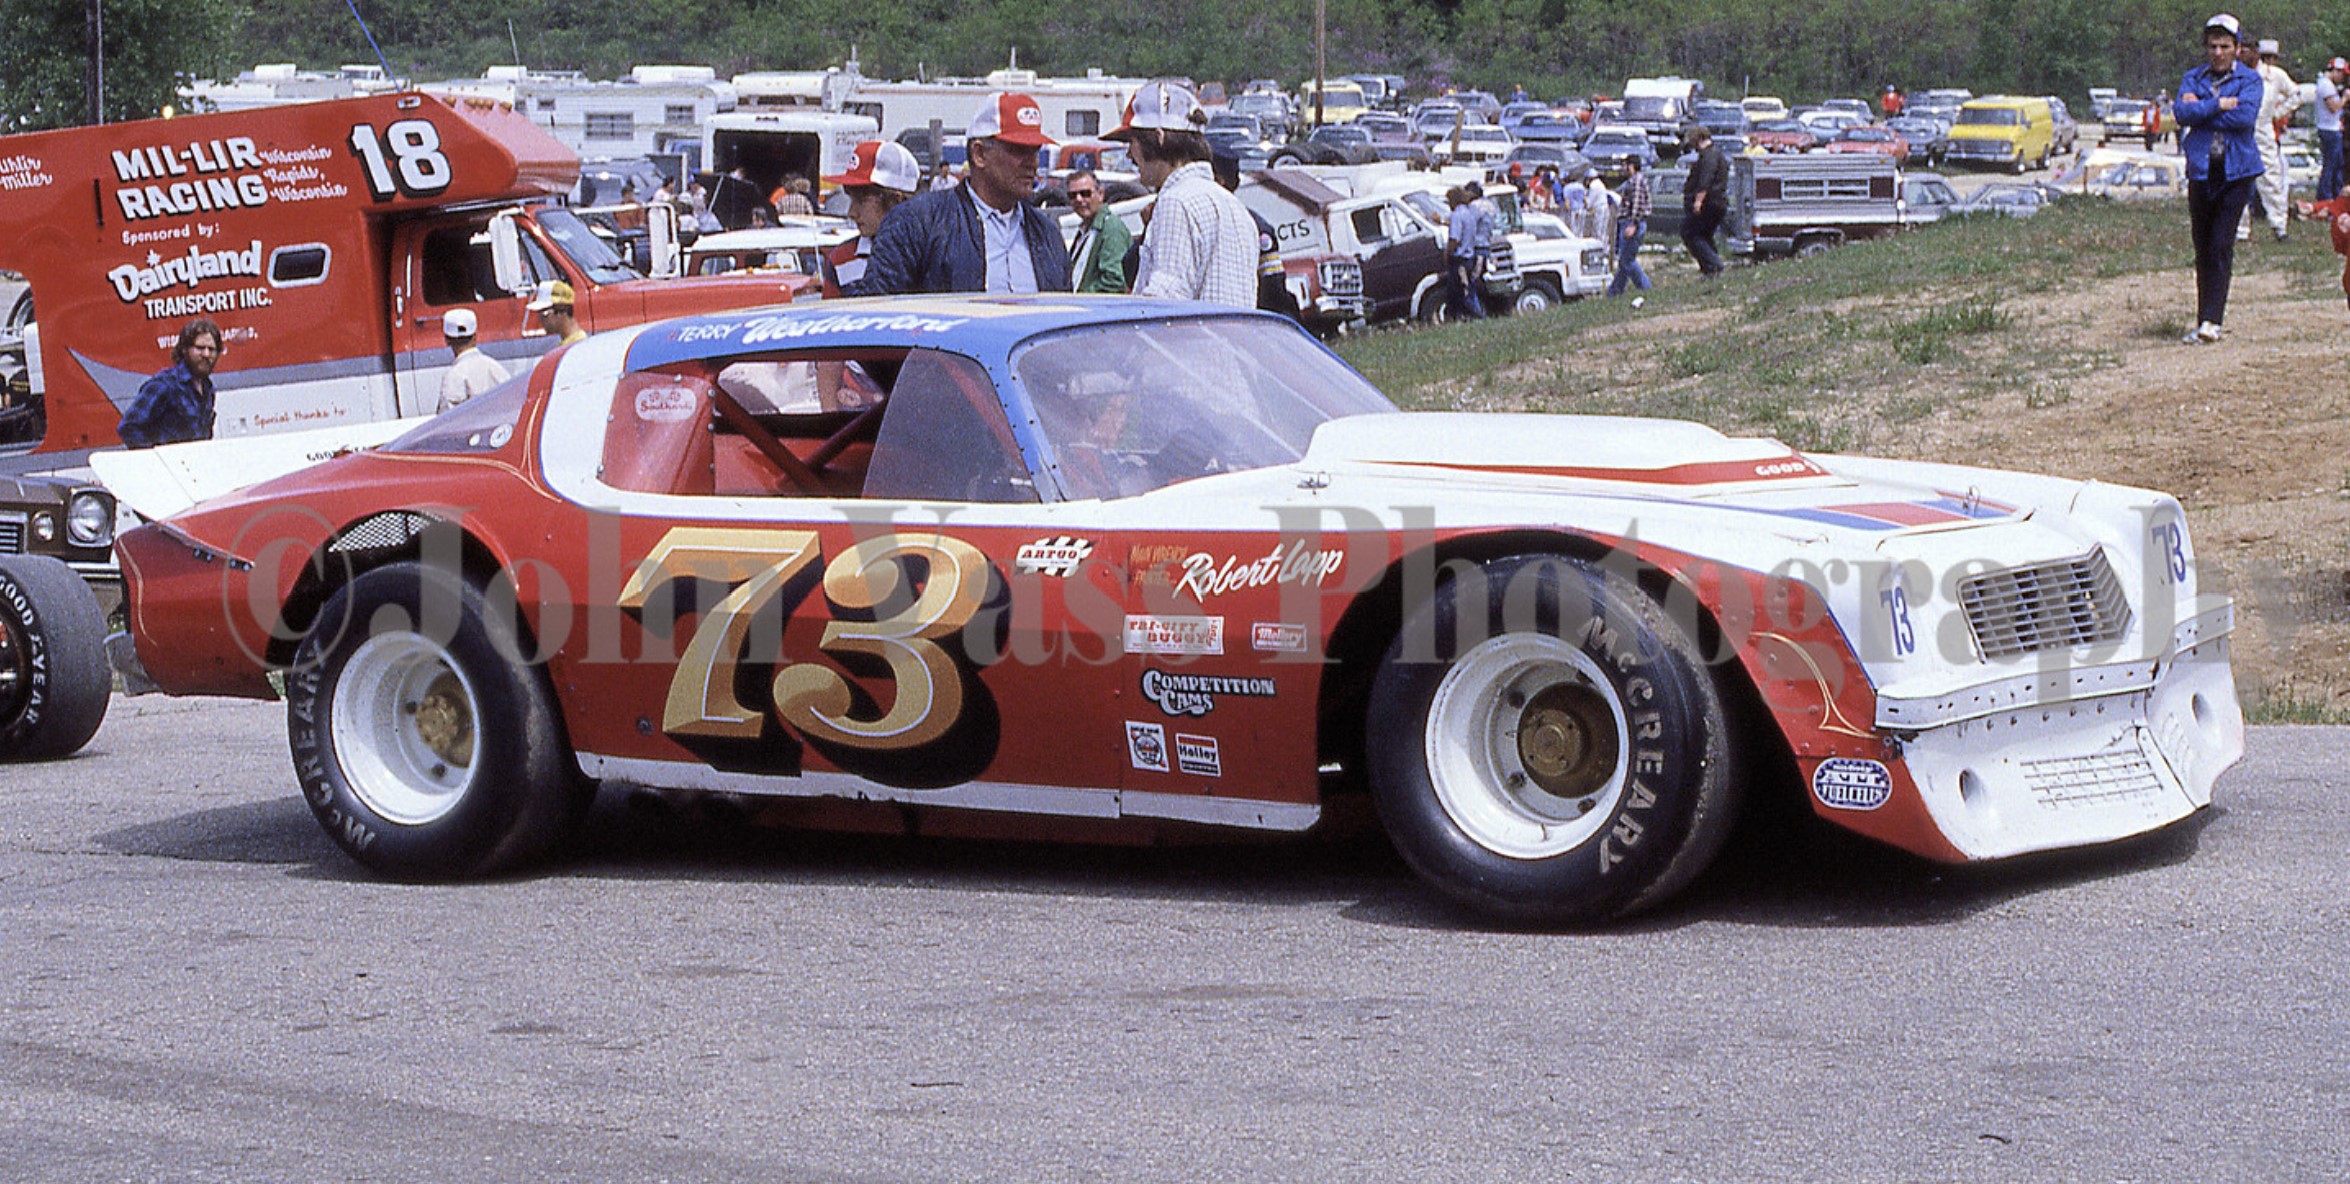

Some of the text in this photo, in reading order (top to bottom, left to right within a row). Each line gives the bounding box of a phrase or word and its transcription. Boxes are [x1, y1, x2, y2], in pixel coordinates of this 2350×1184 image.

[111, 136, 263, 182] MIL-LIR
[350, 120, 452, 195] 18
[116, 174, 269, 220] RACING
[122, 222, 220, 246] Sponsored by:
[108, 240, 263, 301] Dairyland
[144, 287, 273, 319] TRANSPORT INC.
[676, 322, 741, 342] TERRY
[1171, 539, 1345, 604] Robert Lapp
[2151, 522, 2186, 584] 73
[617, 527, 990, 750] 73
[1879, 586, 1915, 655] 73
[1142, 669, 1276, 701] COMPETITION
[1160, 690, 1213, 715] CAMS
